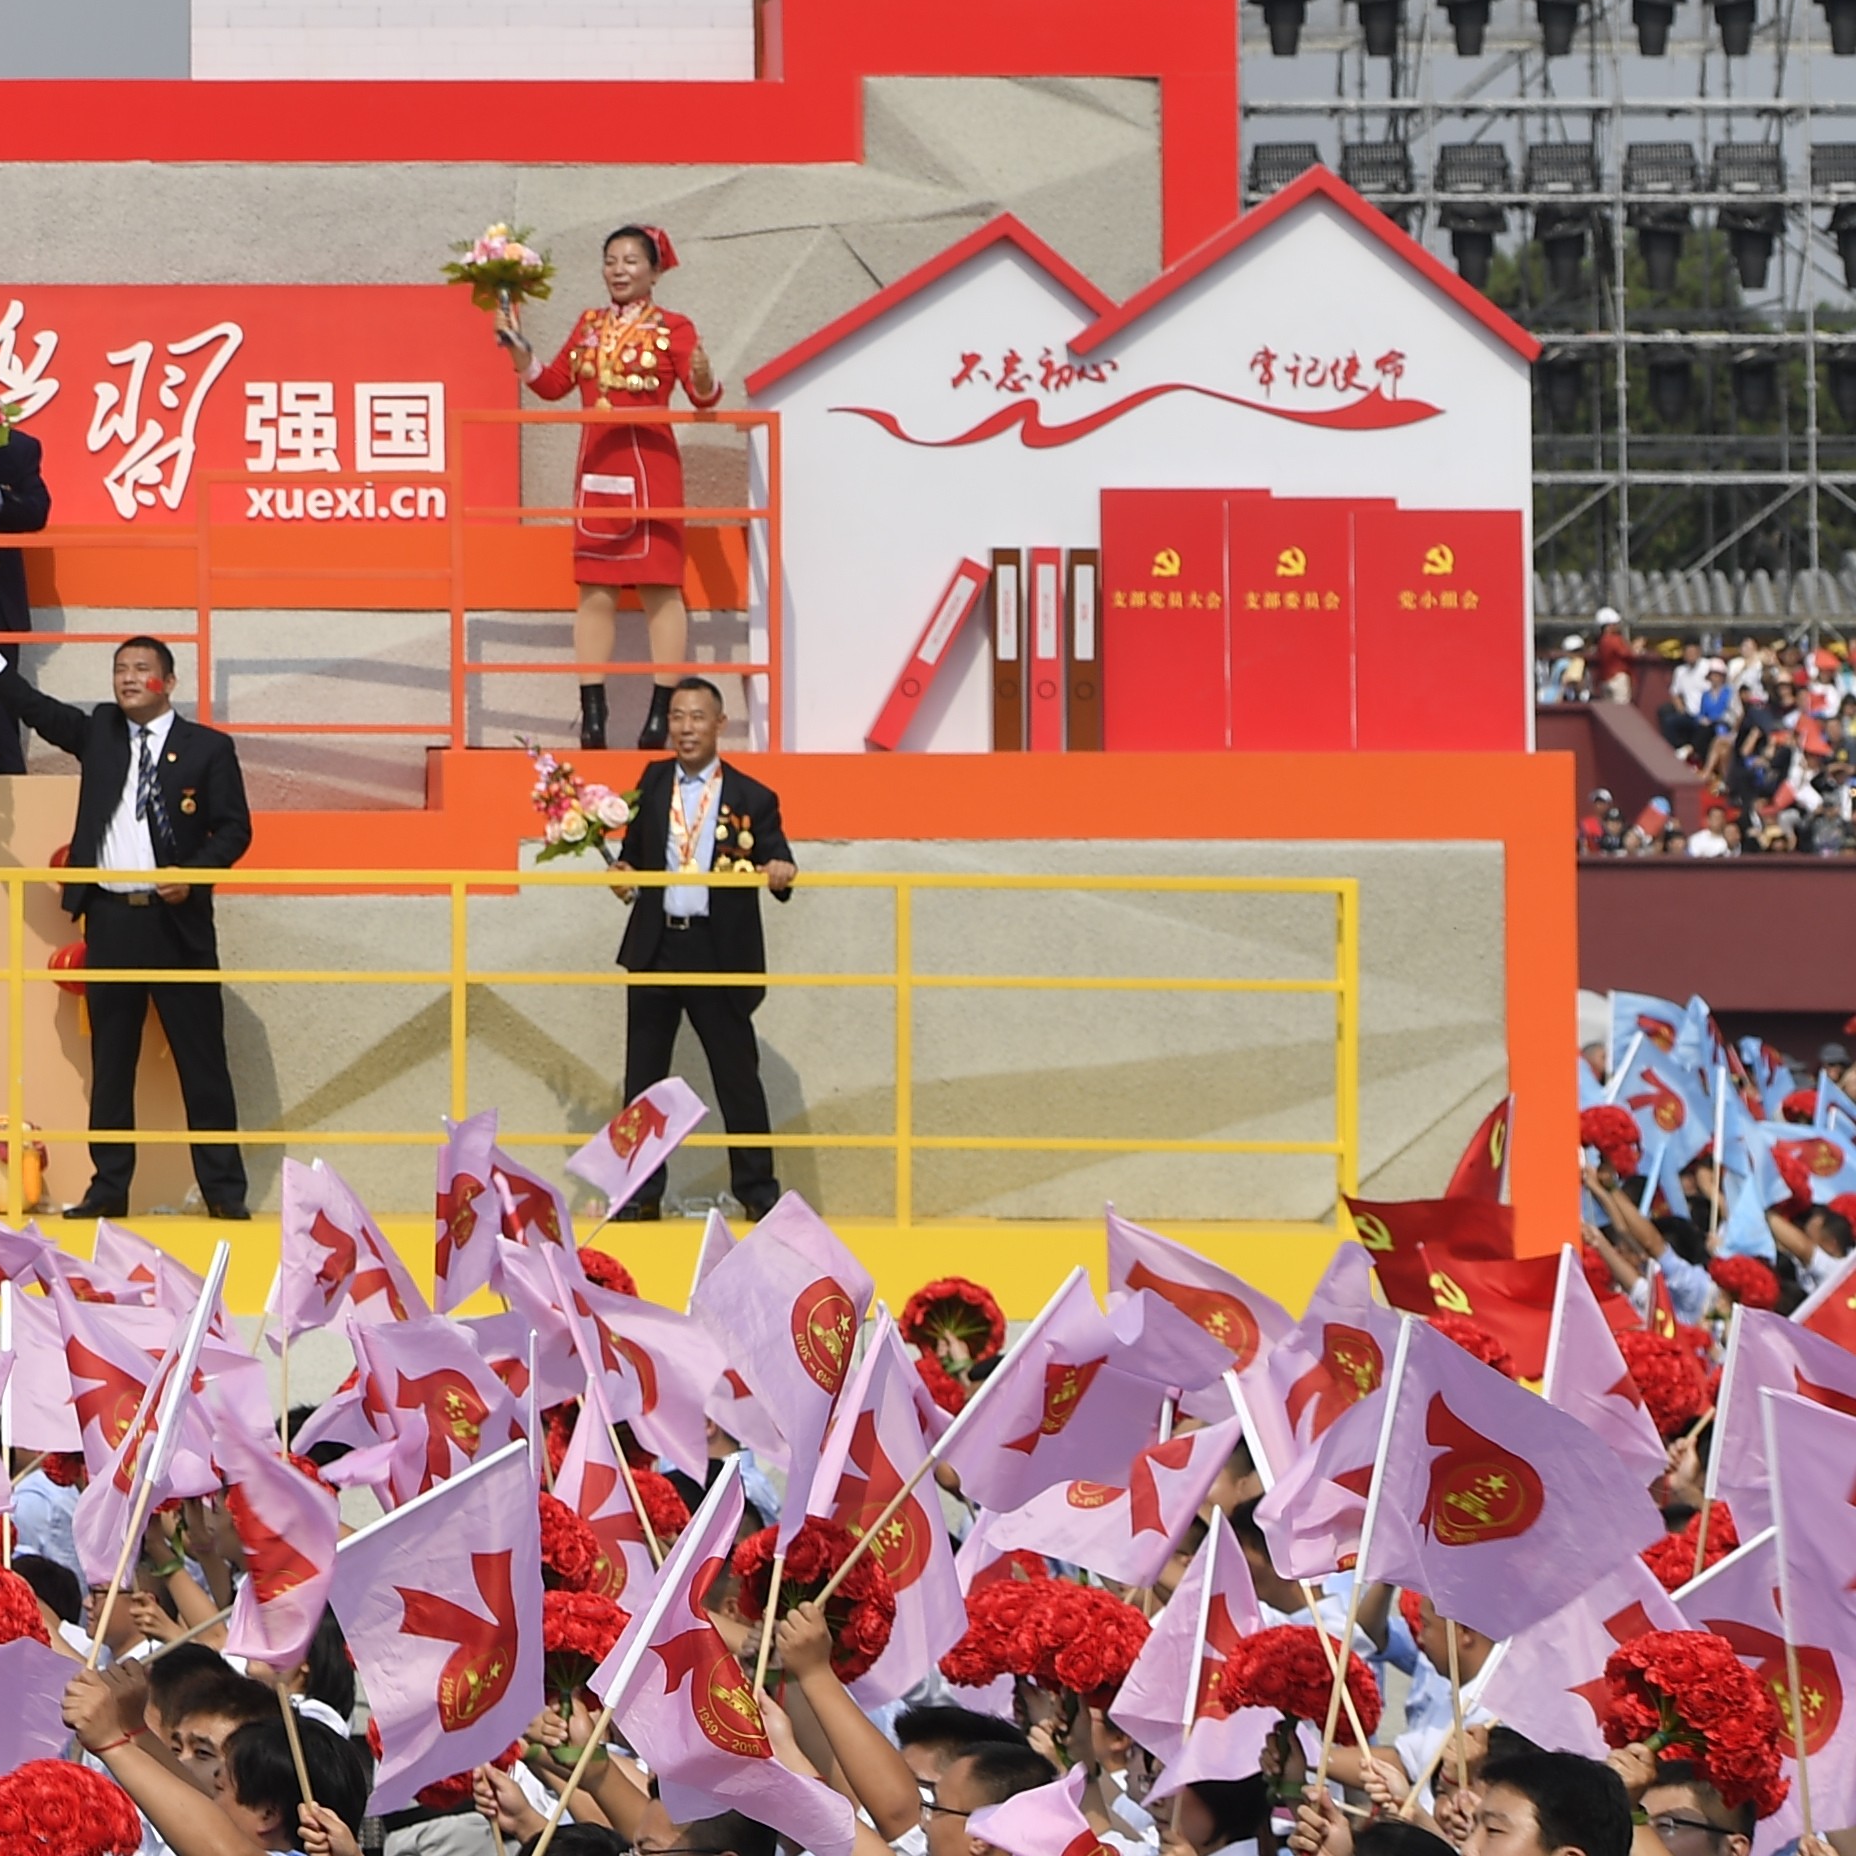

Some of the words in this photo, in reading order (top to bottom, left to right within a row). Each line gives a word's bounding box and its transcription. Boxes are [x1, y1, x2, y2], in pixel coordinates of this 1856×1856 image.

[951, 346, 1119, 394] 不忘初心
[1249, 343, 1407, 401] 牢记使命
[245, 482, 446, 520] xuexi.cn
[1111, 590, 1223, 610] 支部党员大会
[1243, 590, 1341, 610] 支部委员会
[1397, 589, 1480, 610] 党小组会
